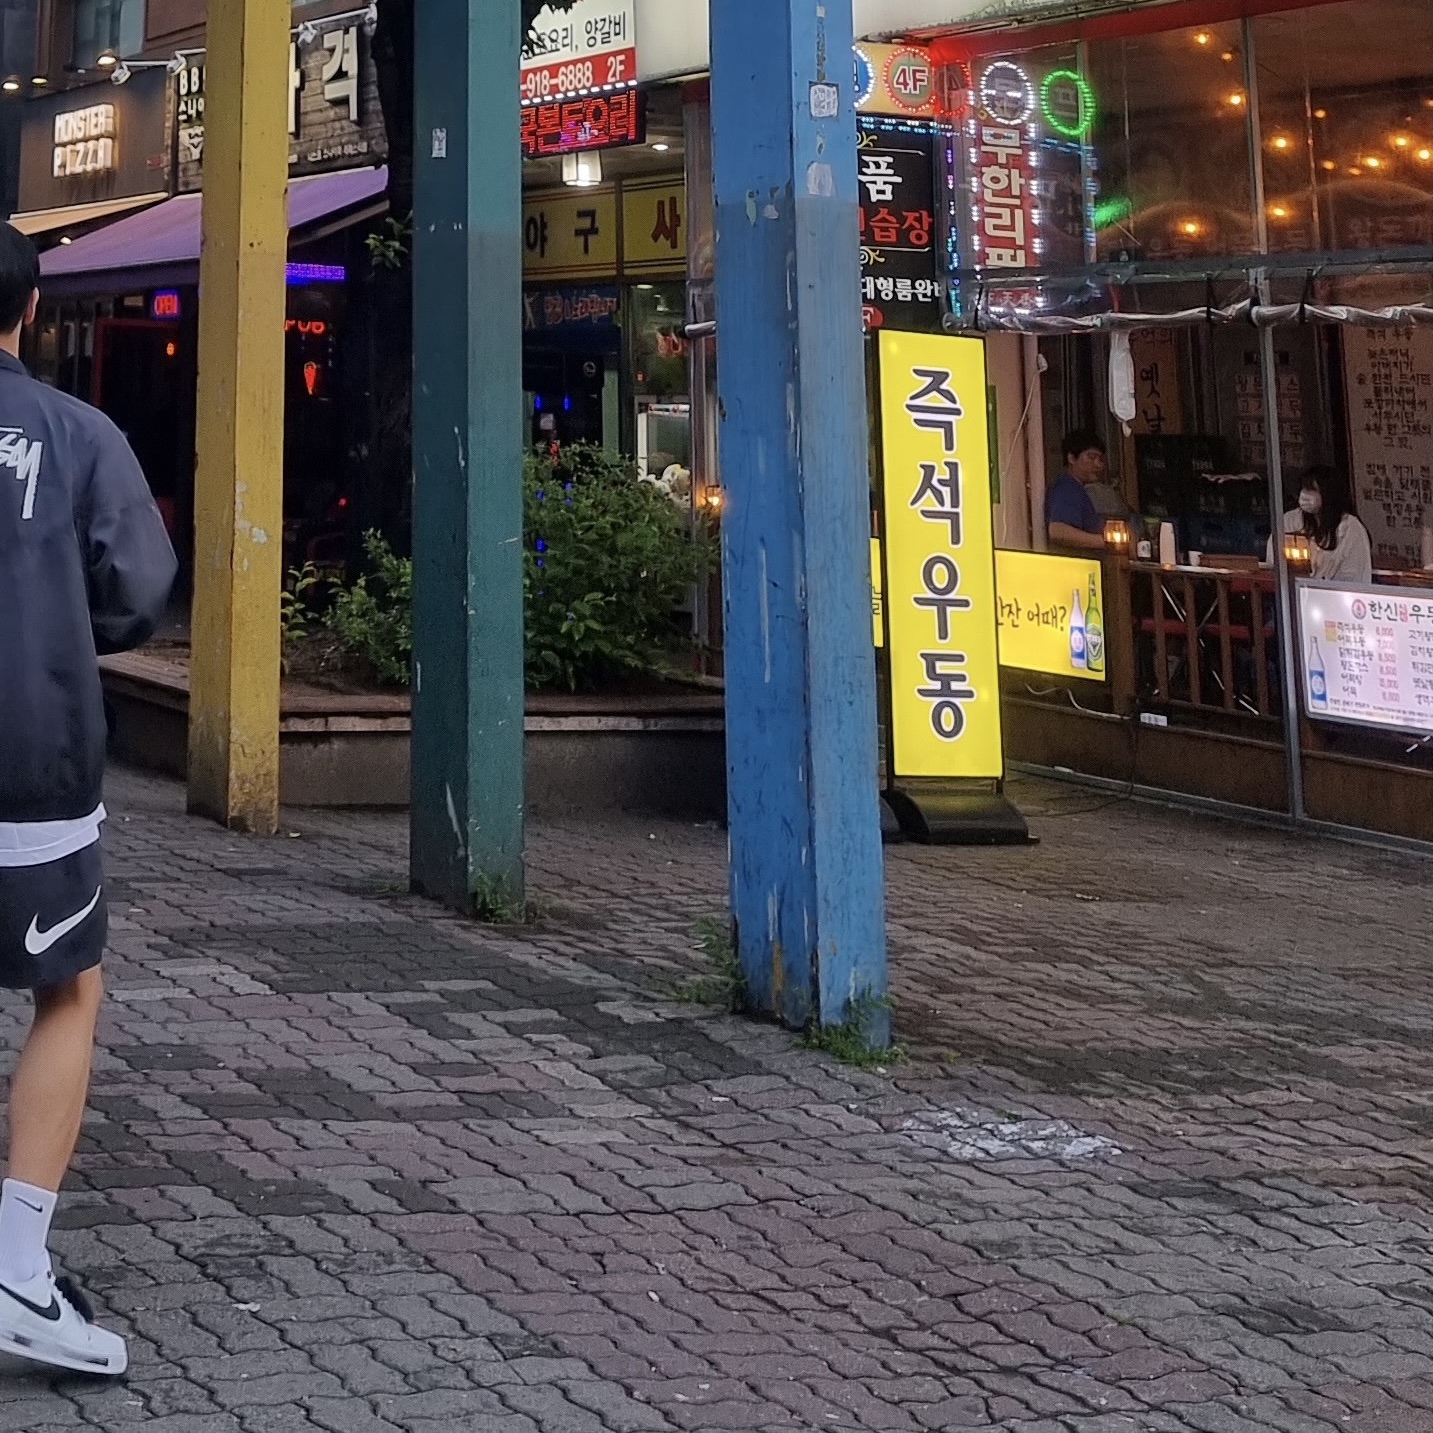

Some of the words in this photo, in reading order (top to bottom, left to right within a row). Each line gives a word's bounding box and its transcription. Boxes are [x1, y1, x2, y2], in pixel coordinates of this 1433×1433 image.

[585, 11, 626, 48] 양갈비
[179, 65, 206, 96] BB
[607, 54, 626, 83] 2F
[893, 66, 928, 94] 4F
[54, 104, 114, 145] MONSTER
[53, 138, 113, 178] PIZZA
[904, 367, 976, 741] 즉석우동
[1027, 602, 1068, 631] 어때?
[1368, 600, 1398, 622] 한신
